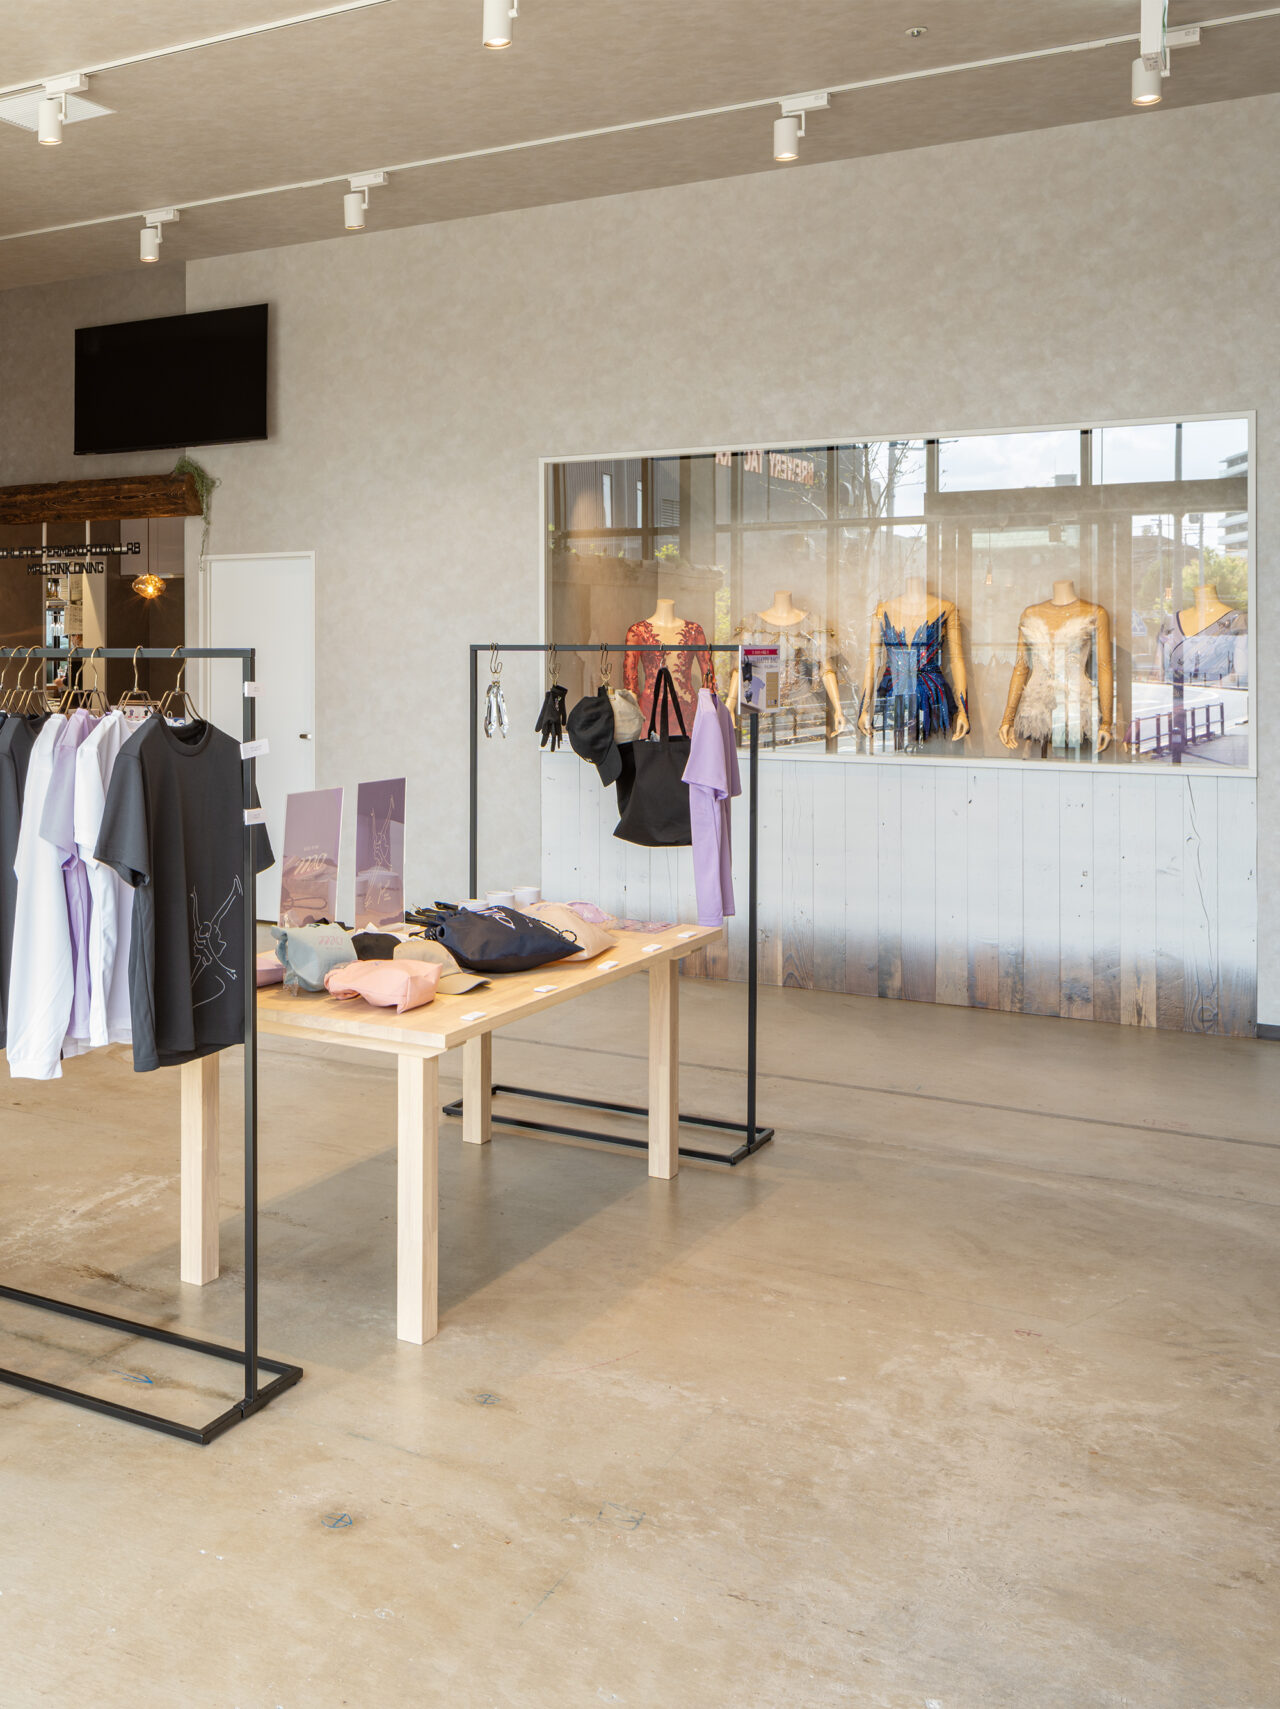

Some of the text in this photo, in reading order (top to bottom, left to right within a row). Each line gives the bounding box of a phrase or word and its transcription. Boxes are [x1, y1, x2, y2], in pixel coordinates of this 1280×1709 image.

[119, 541, 140, 555] LAB
[49, 562, 71, 575] RINK
[73, 561, 104, 574] DINING
